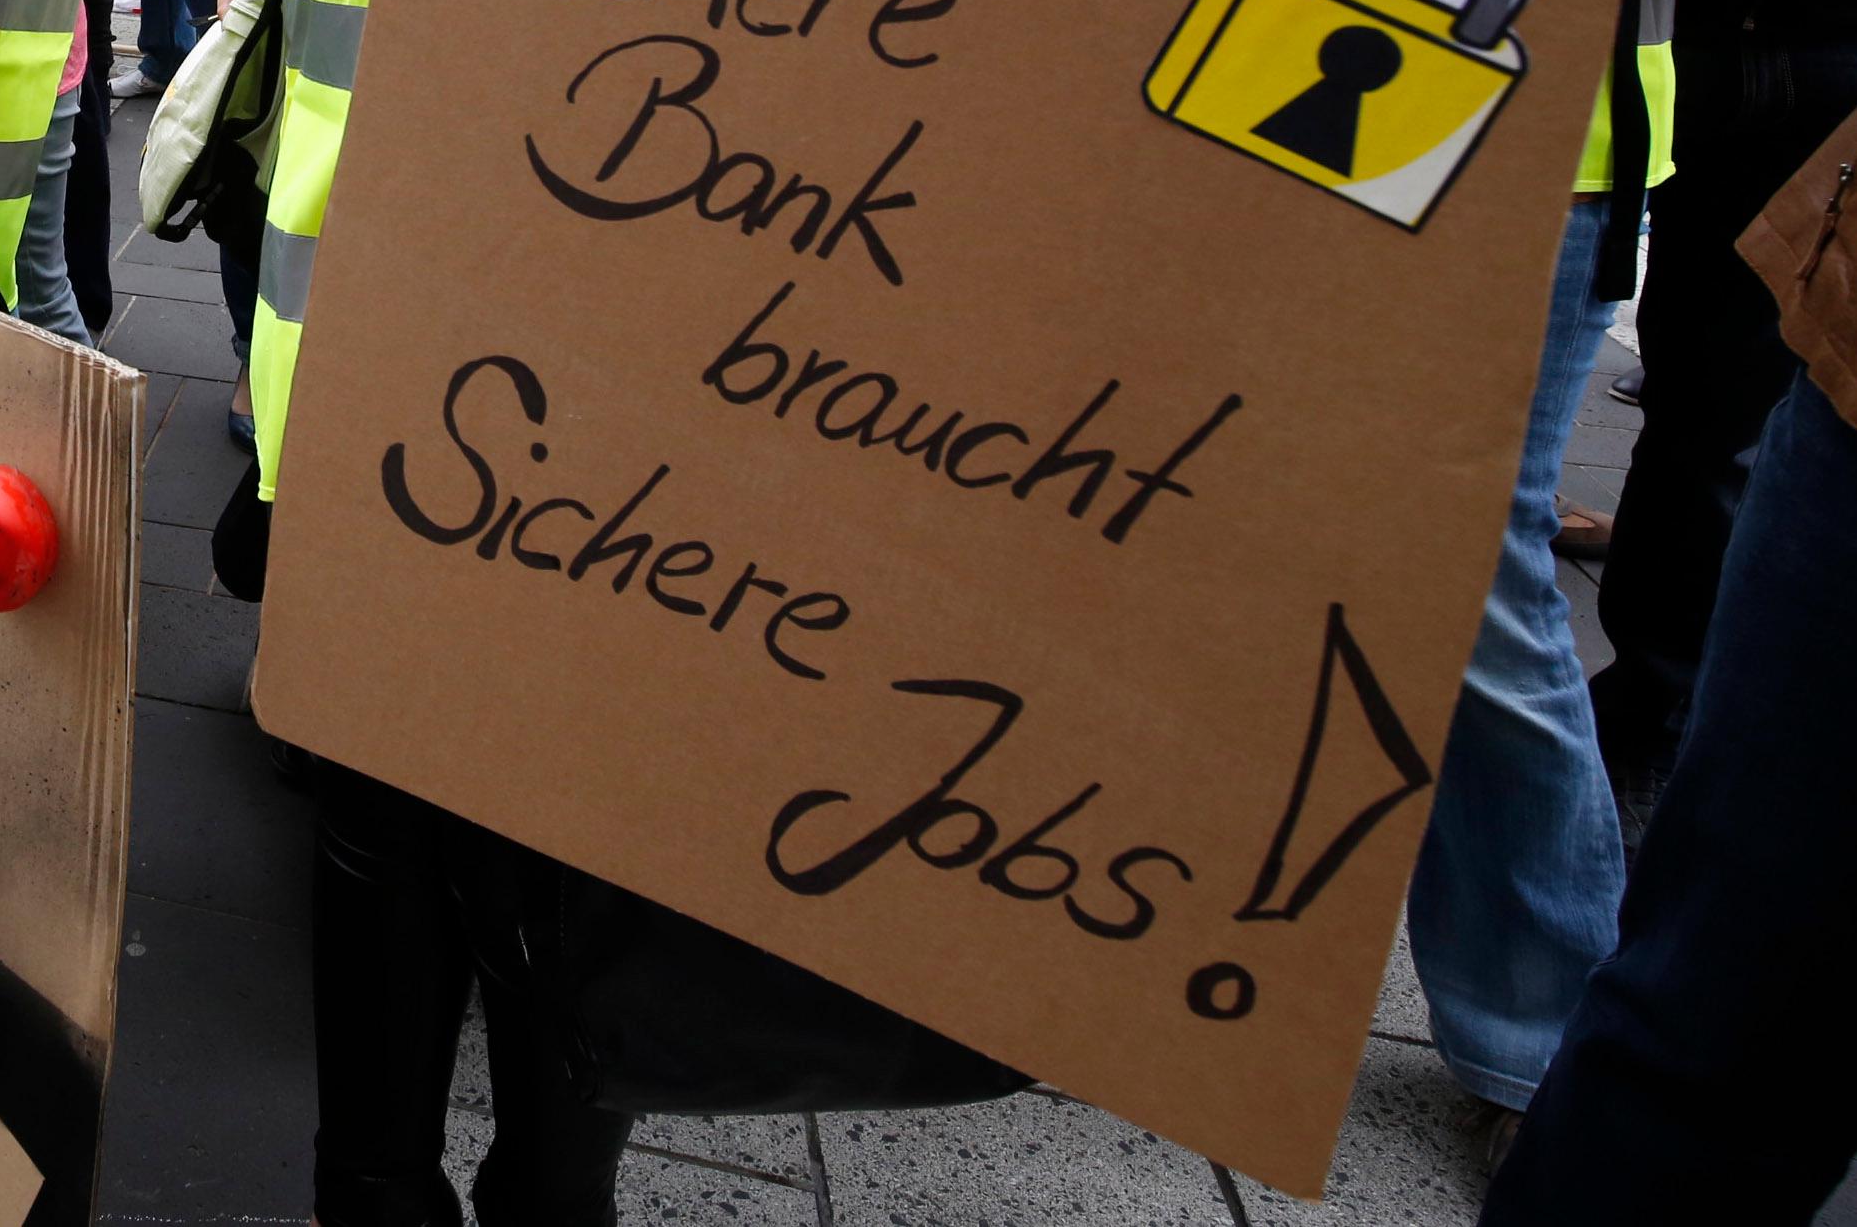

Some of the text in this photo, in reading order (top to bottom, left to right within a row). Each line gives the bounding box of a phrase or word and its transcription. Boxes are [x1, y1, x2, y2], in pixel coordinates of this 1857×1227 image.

[524, 33, 924, 286] Bank
[380, 354, 851, 682] Sichere
[702, 281, 1244, 544] braucht
